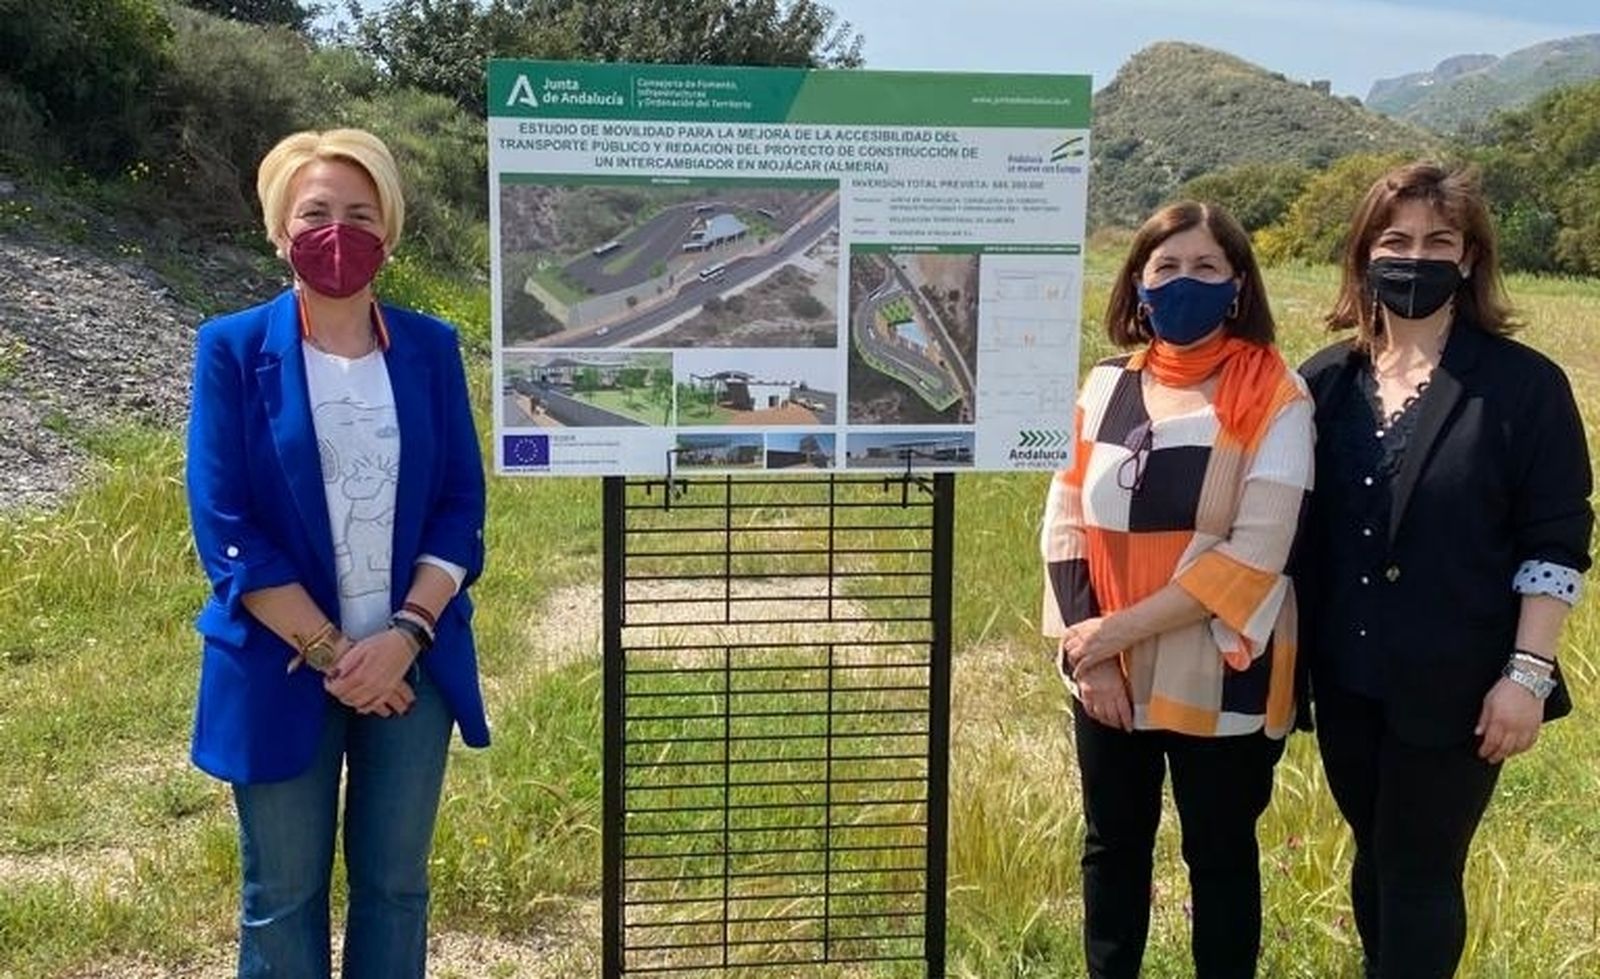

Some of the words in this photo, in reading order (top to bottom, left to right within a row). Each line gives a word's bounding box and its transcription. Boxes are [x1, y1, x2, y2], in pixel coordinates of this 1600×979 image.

[543, 77, 580, 91] Junta
[542, 91, 559, 103] de
[561, 91, 624, 106] Andalucía
[519, 122, 578, 135] ESTUDIO
[580, 123, 599, 136] DE
[602, 124, 675, 138] MOVILIDAD
[678, 126, 714, 139] PARA
[718, 127, 734, 139] LA
[739, 128, 792, 140] MEJORA
[795, 129, 813, 141] DE
[816, 129, 833, 141] LA
[835, 130, 932, 142] ACCESIBILIDAD
[934, 131, 959, 143] DEL
[499, 138, 587, 151] TRANSPORTE
[592, 138, 650, 153] PÚBLICO
[654, 142, 662, 153] Y
[665, 141, 733, 154] REDACIÓN
[736, 143, 760, 155] DEL
[764, 144, 834, 157] PROYECTO
[838, 145, 855, 157] DE
[857, 145, 959, 159] CONSTRUCCIÓN
[962, 147, 980, 159] DE
[595, 157, 613, 168] UN
[616, 157, 734, 170] INTERCAMBIADOR
[737, 159, 756, 170] EN
[758, 157, 821, 172] MOJÁCAR
[823, 159, 889, 173] (ALMERÍA)
